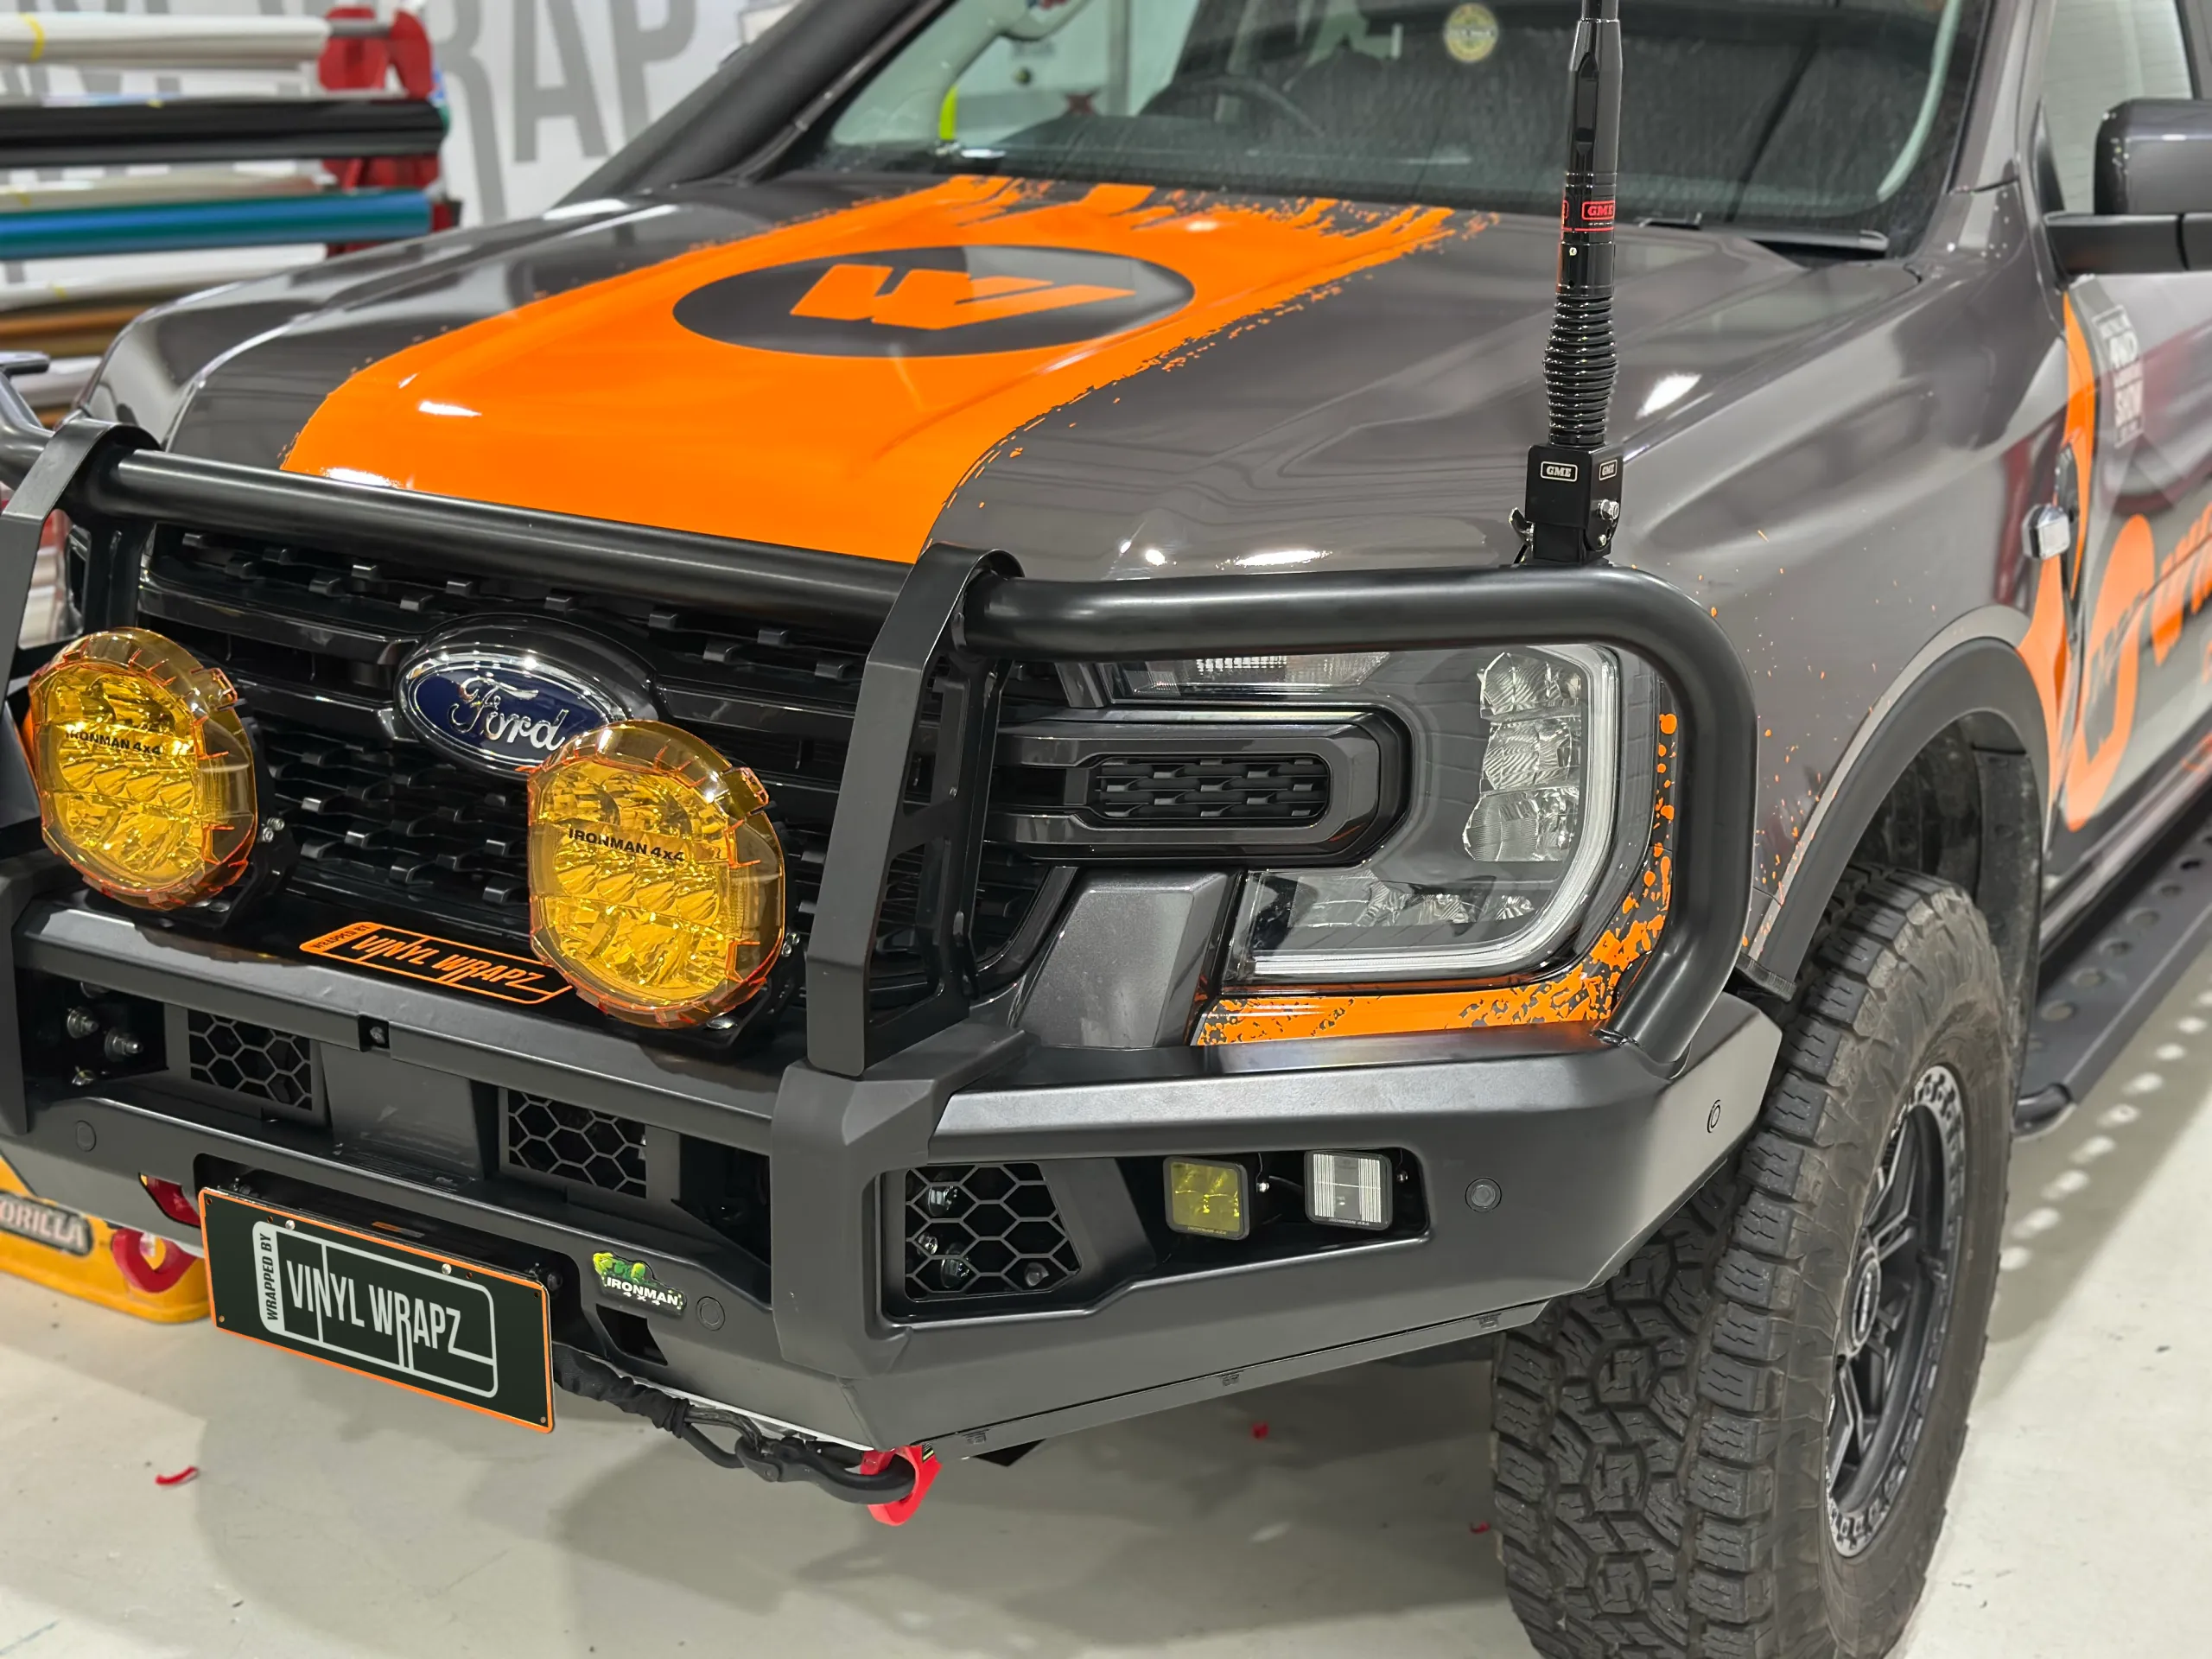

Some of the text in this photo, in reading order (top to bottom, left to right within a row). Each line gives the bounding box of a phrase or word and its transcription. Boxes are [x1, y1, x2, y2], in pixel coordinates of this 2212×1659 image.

[307, 0, 696, 223] RAP
[1546, 466, 1572, 477] GME
[1602, 464, 1614, 476] GME
[448, 677, 569, 751] Ford
[66, 732, 130, 749] IRONMAN
[569, 829, 648, 855] IRONMAN
[351, 935, 546, 986] VINYL WRAPZ
[0, 1198, 85, 1249] ORILLA
[259, 1233, 278, 1321] WRAPPED BY
[607, 1277, 679, 1306] IRONMAN
[286, 1255, 463, 1363] VINYL WRAPZ
